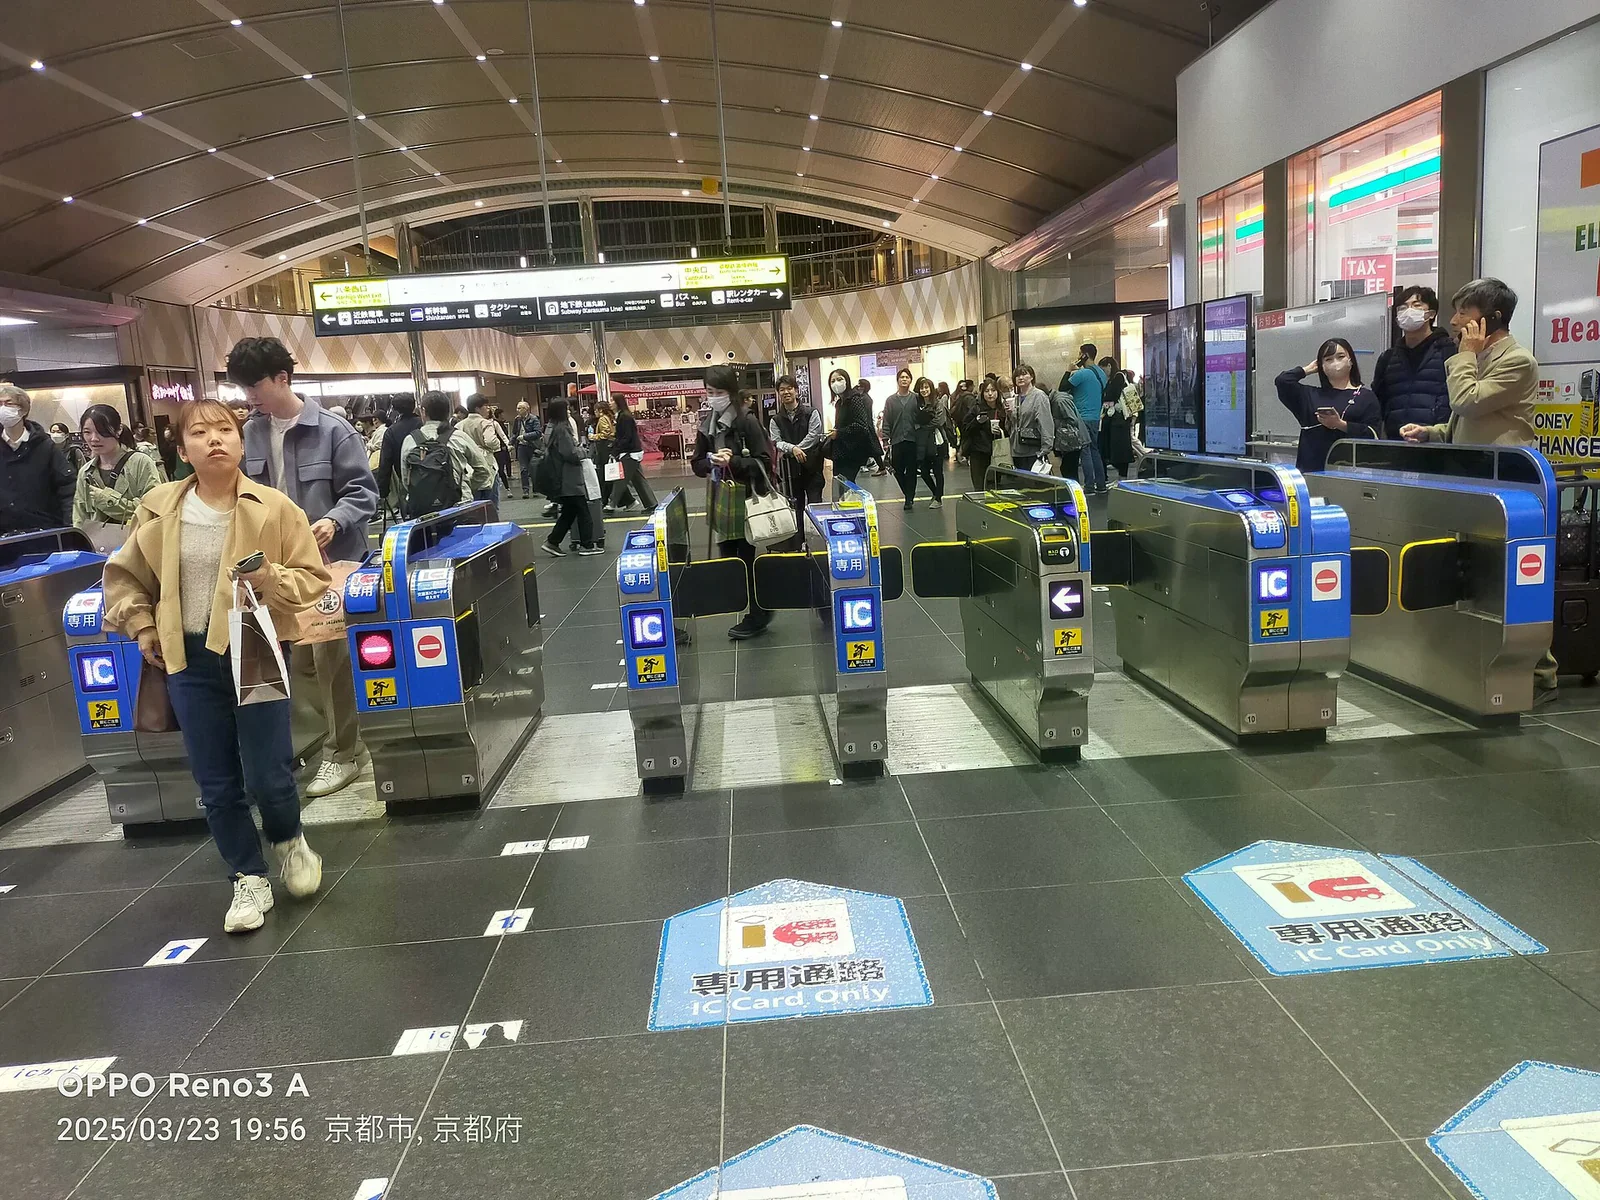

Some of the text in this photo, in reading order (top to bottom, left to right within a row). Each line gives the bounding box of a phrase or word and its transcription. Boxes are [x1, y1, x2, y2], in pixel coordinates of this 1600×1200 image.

[1575, 221, 1600, 251] EL
[726, 289, 768, 298] 駅レンタカー
[1364, 278, 1385, 295] EE
[675, 293, 690, 301] バス
[353, 310, 384, 319] 近鉄電車
[424, 306, 448, 315] 新幹線
[489, 303, 518, 312] タクシー
[1534, 413, 1574, 430] ONEY
[1255, 521, 1281, 535] 専用
[836, 540, 857, 554] IC
[835, 558, 863, 572] 専用
[623, 572, 651, 586] 専用
[1259, 572, 1288, 597] IC
[348, 585, 374, 598] 専用
[67, 613, 96, 628] 専用
[844, 602, 872, 627] IC
[633, 616, 662, 641] IC
[83, 658, 115, 686] IC
[1247, 715, 1256, 723] 10
[1048, 730, 1054, 738] 9
[1072, 728, 1081, 736] 10
[872, 742, 878, 750] 9
[646, 760, 652, 768] 7
[672, 758, 677, 766] 8
[118, 805, 125, 813] 5
[1268, 912, 1474, 946] 専用通路
[1297, 934, 1494, 964] IC Card Only
[691, 958, 886, 996] 専用通路
[691, 984, 890, 1016] IC Card Only
